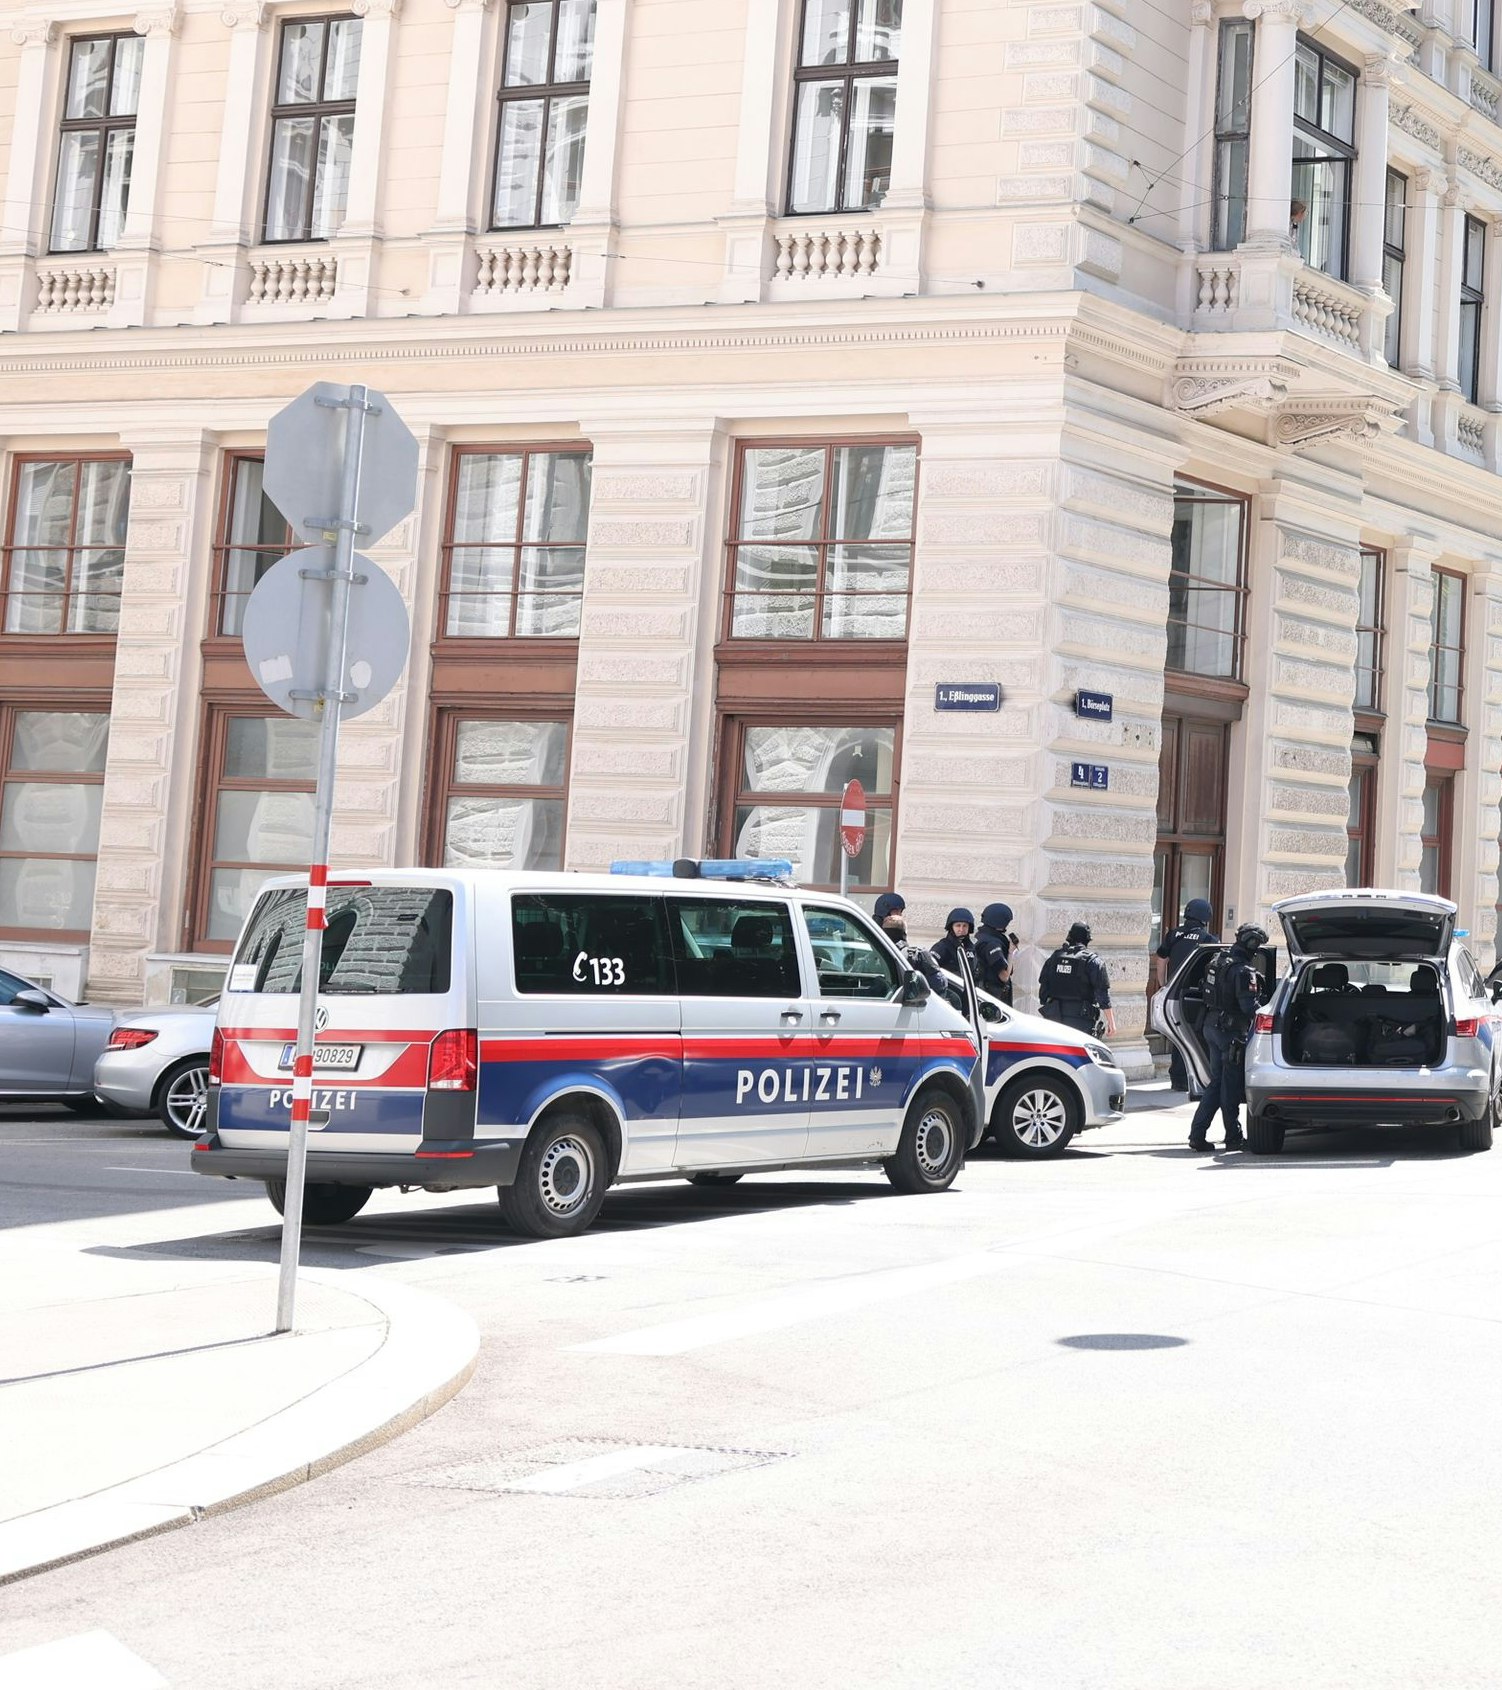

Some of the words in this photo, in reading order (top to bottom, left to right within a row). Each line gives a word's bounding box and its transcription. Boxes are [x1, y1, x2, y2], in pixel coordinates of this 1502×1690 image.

[1078, 765, 1084, 779] 4
[1097, 771, 1103, 783] 2
[589, 957, 626, 985] 133
[736, 1066, 864, 1104] POLIZEI
[270, 1089, 357, 1111] POIZEI
